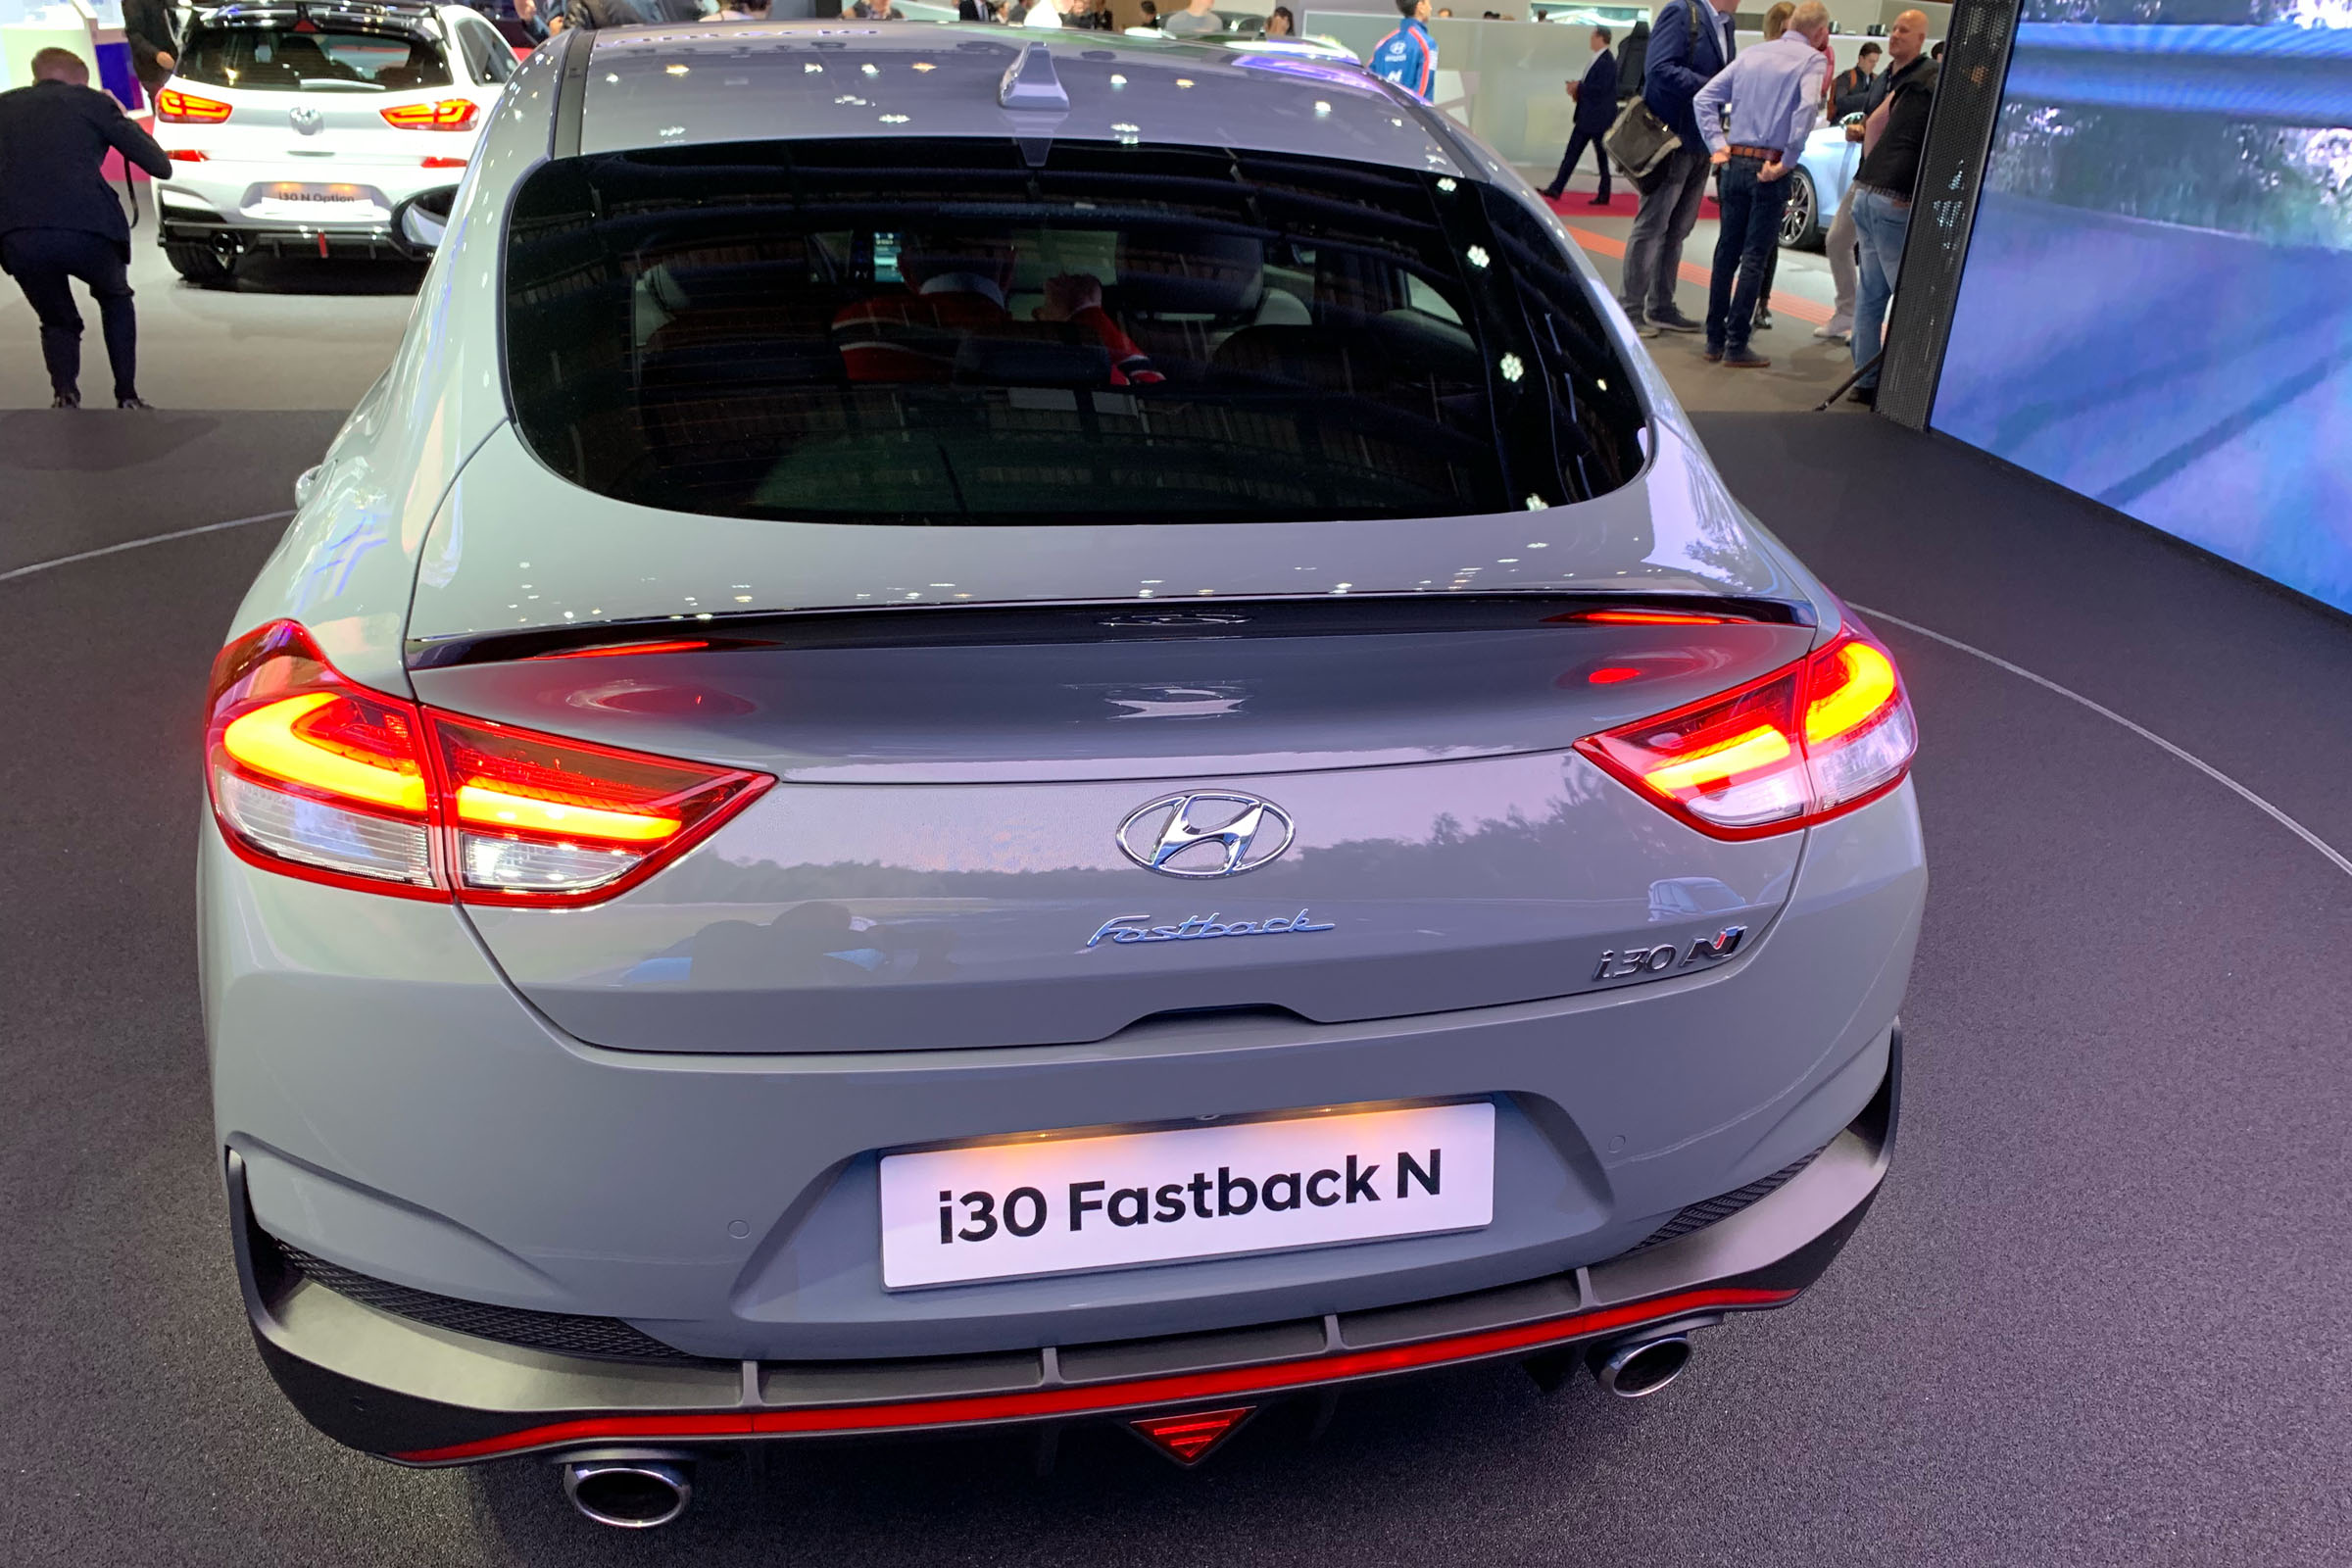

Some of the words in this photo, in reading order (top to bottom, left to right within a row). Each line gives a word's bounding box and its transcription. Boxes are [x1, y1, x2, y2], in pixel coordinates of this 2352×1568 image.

[314, 193, 355, 203] Option
[1086, 908, 1336, 947] Fastback
[1592, 944, 1677, 980] i30
[1679, 925, 1748, 966] N
[939, 1190, 1048, 1245] i30
[1069, 1154, 1382, 1232] Fastback
[1396, 1149, 1441, 1199] N
